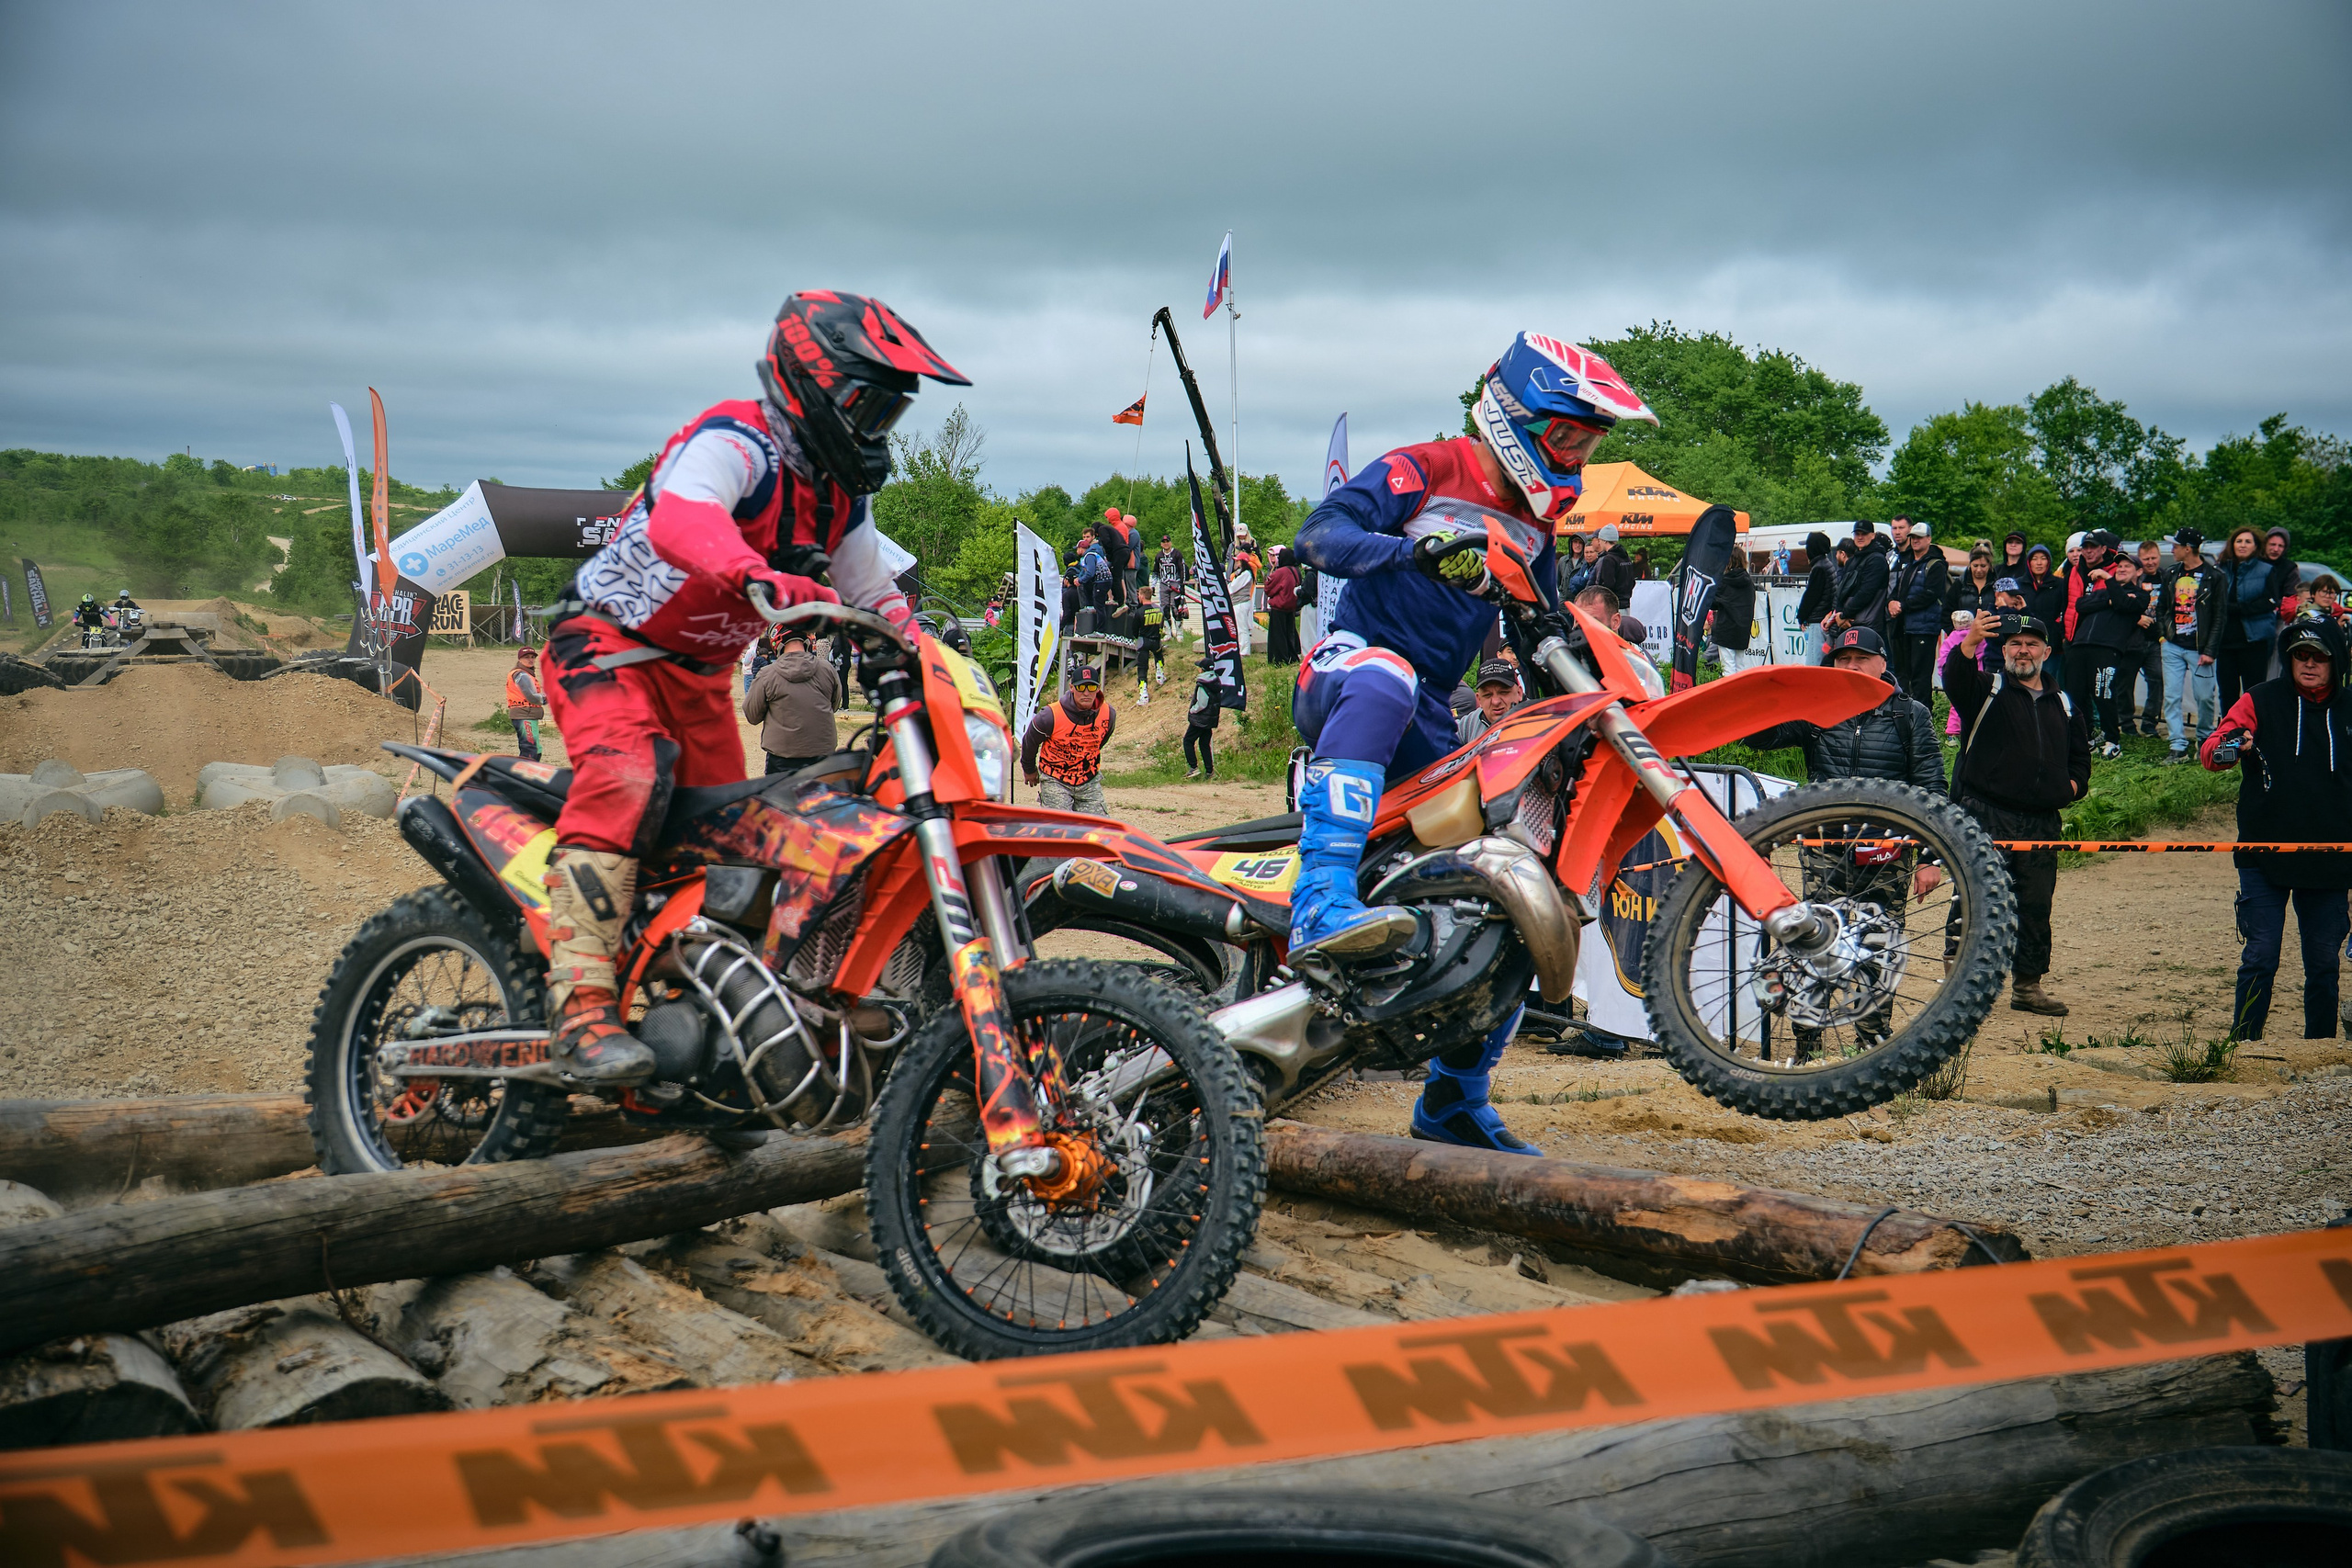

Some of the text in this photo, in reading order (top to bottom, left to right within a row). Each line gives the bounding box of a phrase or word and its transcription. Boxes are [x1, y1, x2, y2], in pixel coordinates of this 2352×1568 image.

[778, 312, 843, 389] 100%
[1489, 376, 1534, 418] LEATT
[1627, 486, 1679, 498] KTM
[1627, 494, 1681, 502] RACING
[447, 496, 476, 519] Центр
[1565, 513, 1586, 525] KTM
[1620, 513, 1654, 525] KTM
[424, 516, 491, 558] МареМед
[447, 546, 484, 570] 31-13-13
[878, 541, 905, 567] Центр
[430, 611, 463, 630] RUN
[1144, 613, 1163, 626] 100
[1785, 636, 1807, 656] ЛО
[1259, 849, 1296, 857] GOLD
[1231, 856, 1293, 880] 46
[409, 1042, 470, 1067] HARD
[1729, 1068, 1765, 1082] GRIP
[896, 1247, 922, 1287] GRIP
